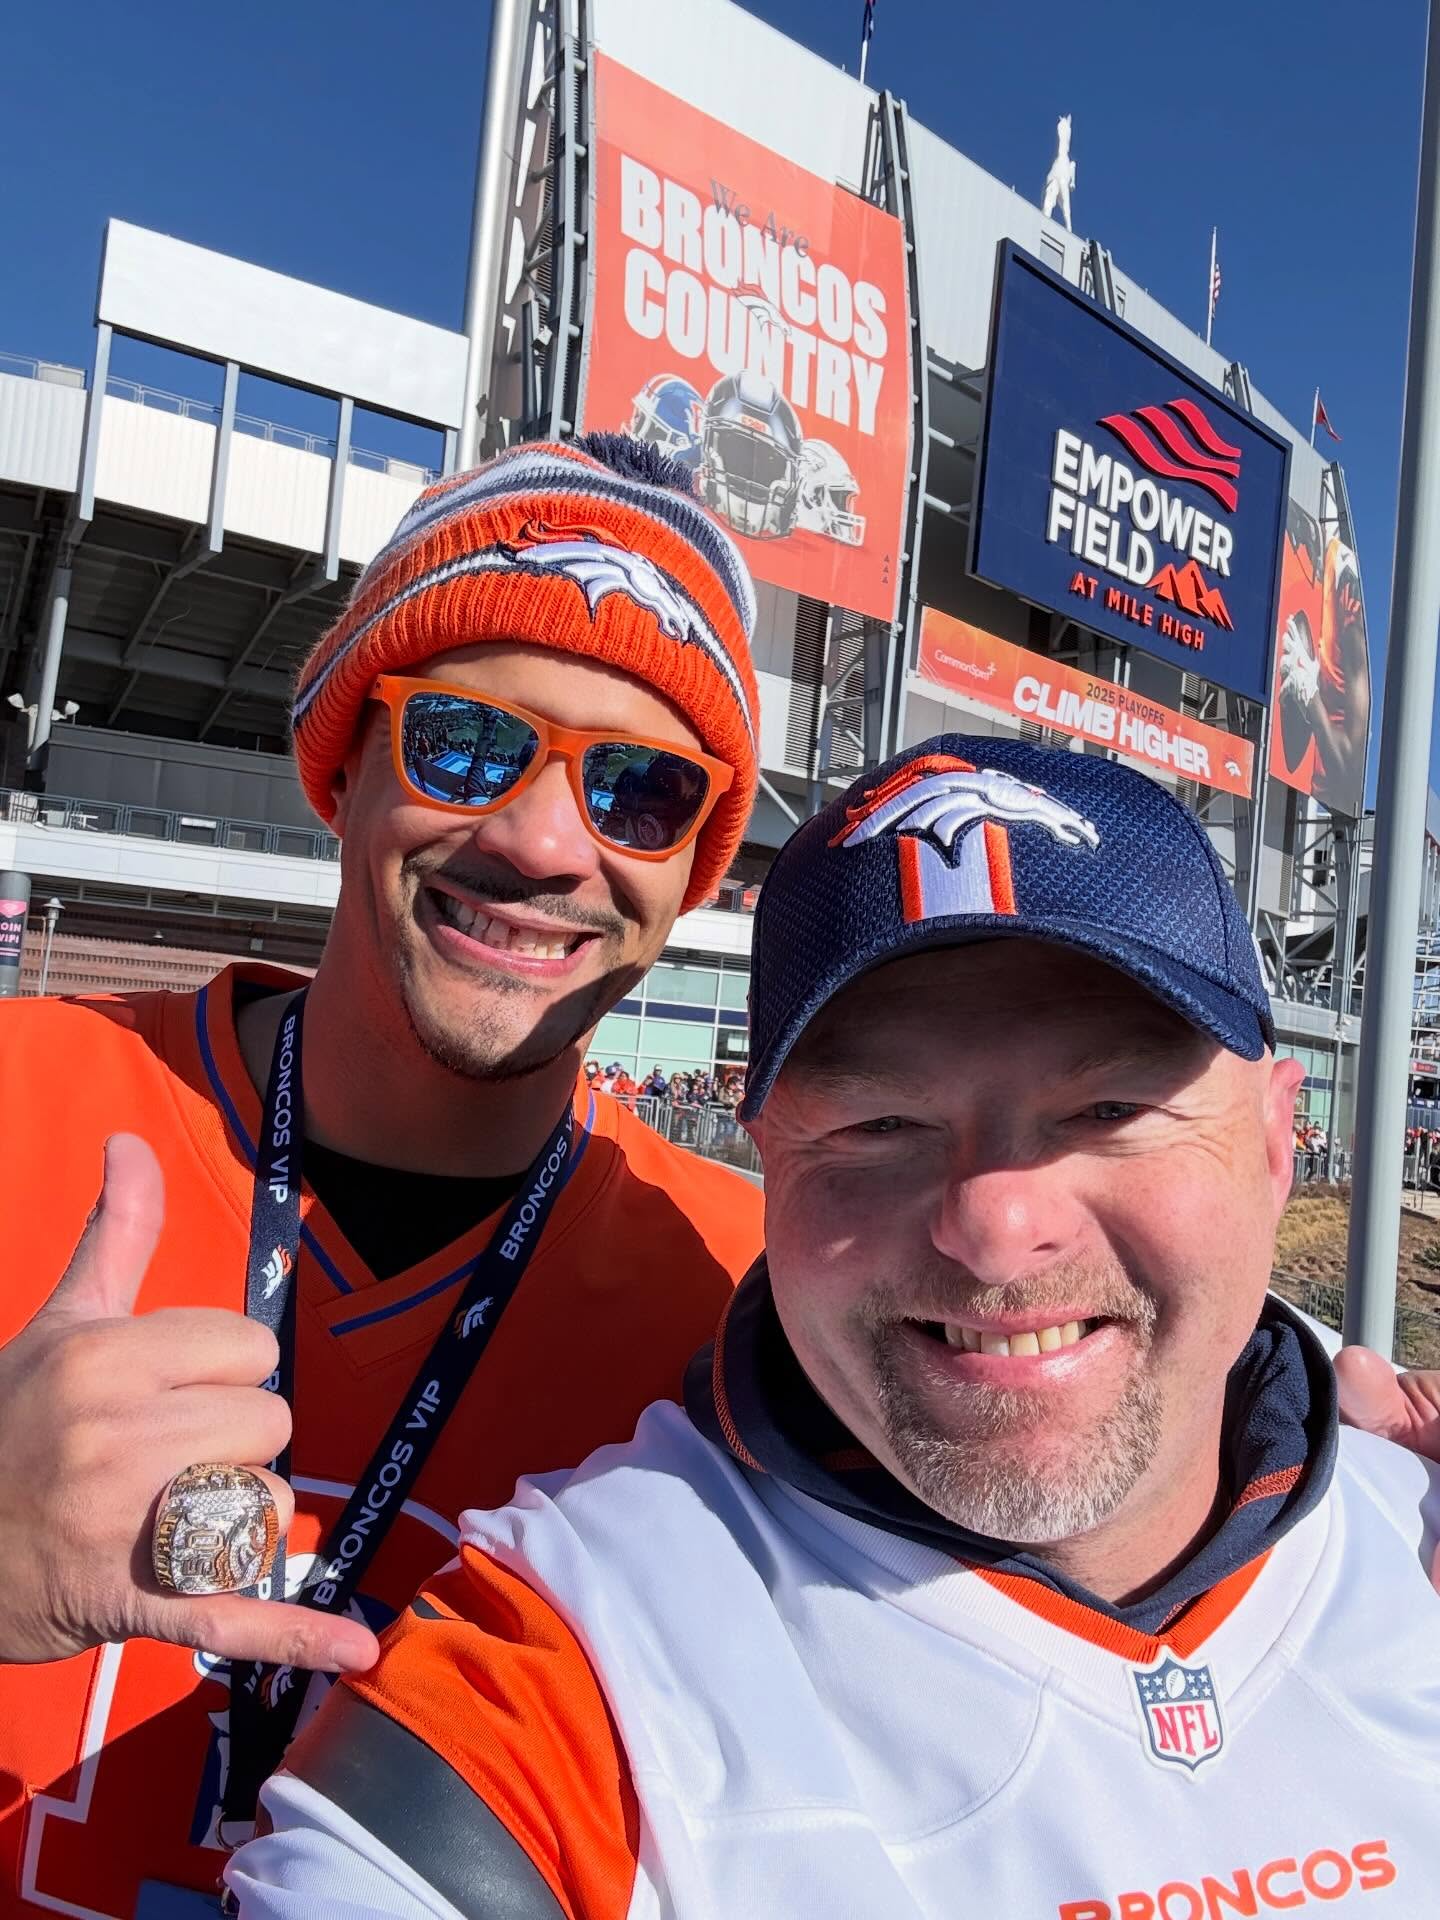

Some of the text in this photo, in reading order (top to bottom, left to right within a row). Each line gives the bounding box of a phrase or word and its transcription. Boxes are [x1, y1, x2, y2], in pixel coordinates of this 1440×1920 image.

[620, 153, 888, 360] BRONCOS
[711, 178, 809, 258] We Are
[624, 248, 885, 437] COUNTRY
[1047, 487, 1154, 585] FIELD
[1052, 428, 1233, 577] EMPOWER
[1071, 572, 1205, 650] AT MILE HIGH
[1013, 676, 1211, 779] CLIMB HIGHER
[1086, 682, 1165, 726] 2025 PLAYOFFS
[0, 921, 21, 932] OIN
[268, 1014, 296, 1204] BRONCOS VIP
[499, 1135, 568, 1261] BRONCOS
[312, 1379, 441, 1606] BRONCOS VIP
[1151, 1703, 1219, 1757] NFL
